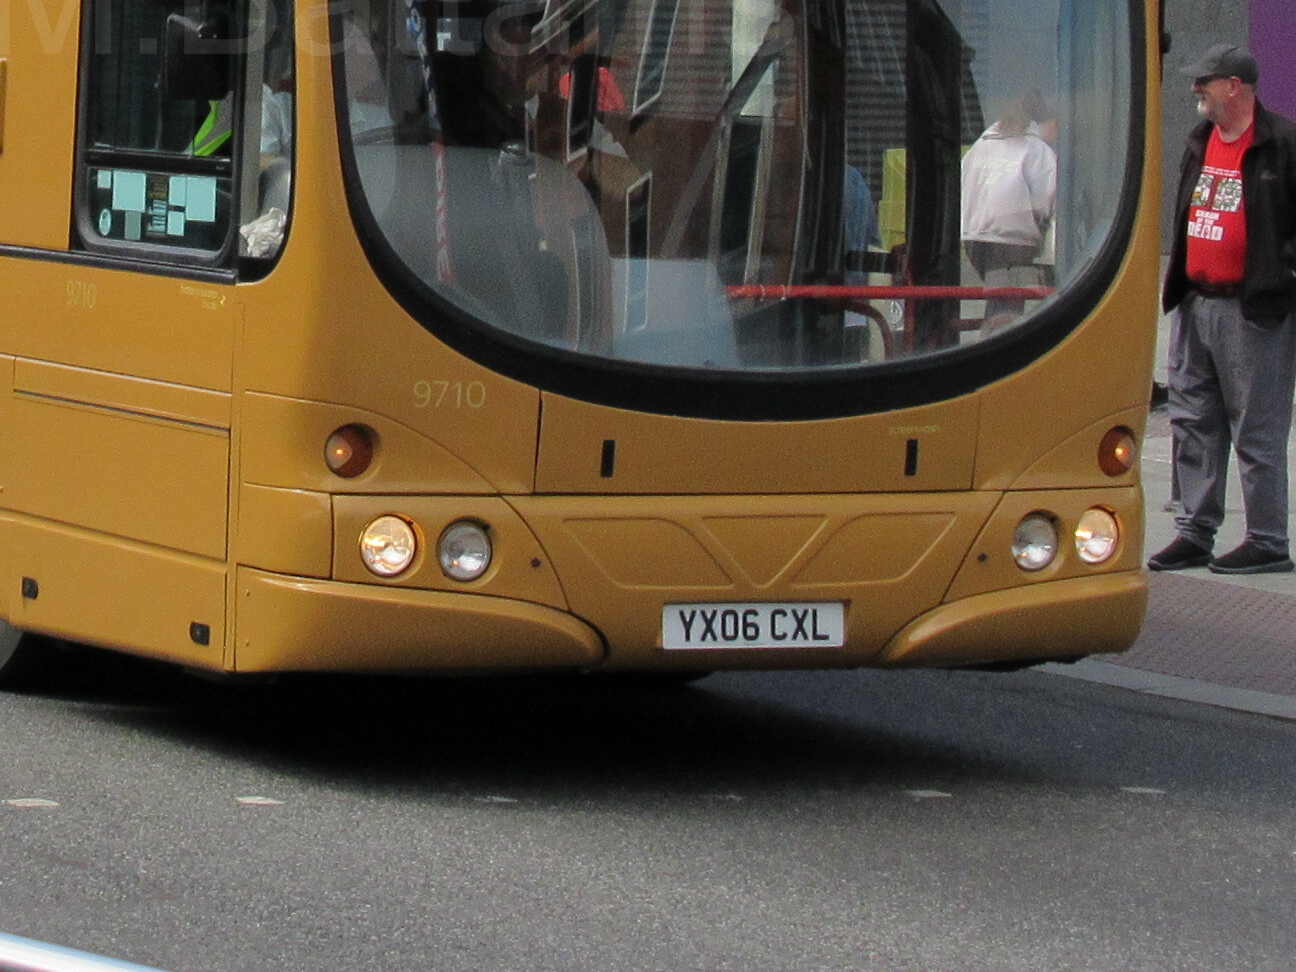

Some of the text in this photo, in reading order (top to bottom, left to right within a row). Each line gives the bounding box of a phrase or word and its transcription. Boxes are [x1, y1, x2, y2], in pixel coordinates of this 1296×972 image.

[413, 380, 487, 409] 9710
[678, 607, 831, 643] YX06 CXL
